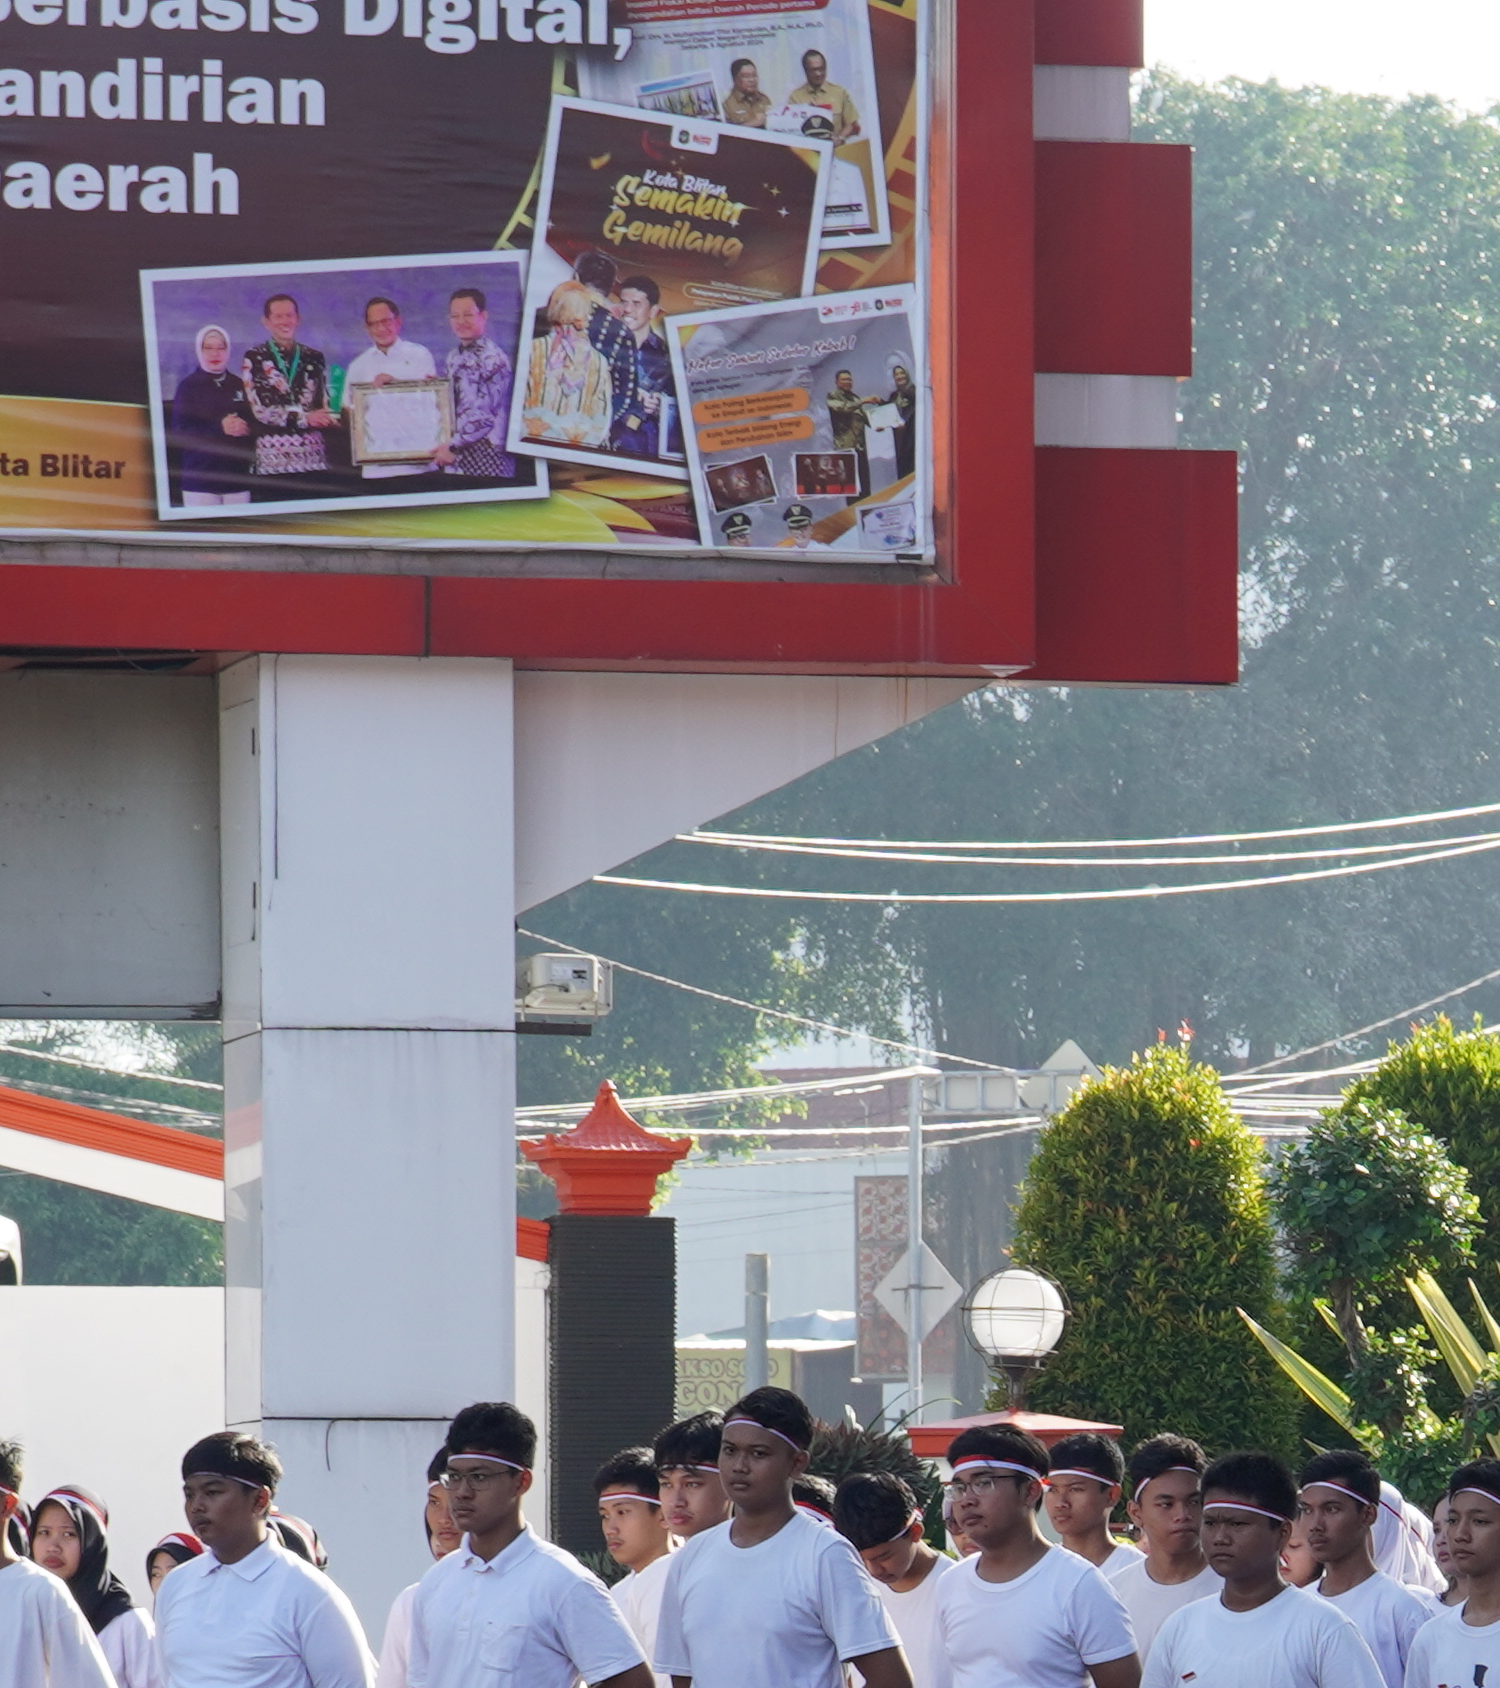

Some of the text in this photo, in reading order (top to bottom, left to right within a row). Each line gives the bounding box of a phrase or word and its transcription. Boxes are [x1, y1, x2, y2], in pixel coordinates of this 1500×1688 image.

[642, 168, 728, 196] Kota Blitar
[613, 174, 744, 222] Semakin
[603, 209, 744, 268] Gemilang
[40, 453, 125, 480] Blitar
[726, 1357, 780, 1379] SO
[677, 1380, 746, 1407] GON
